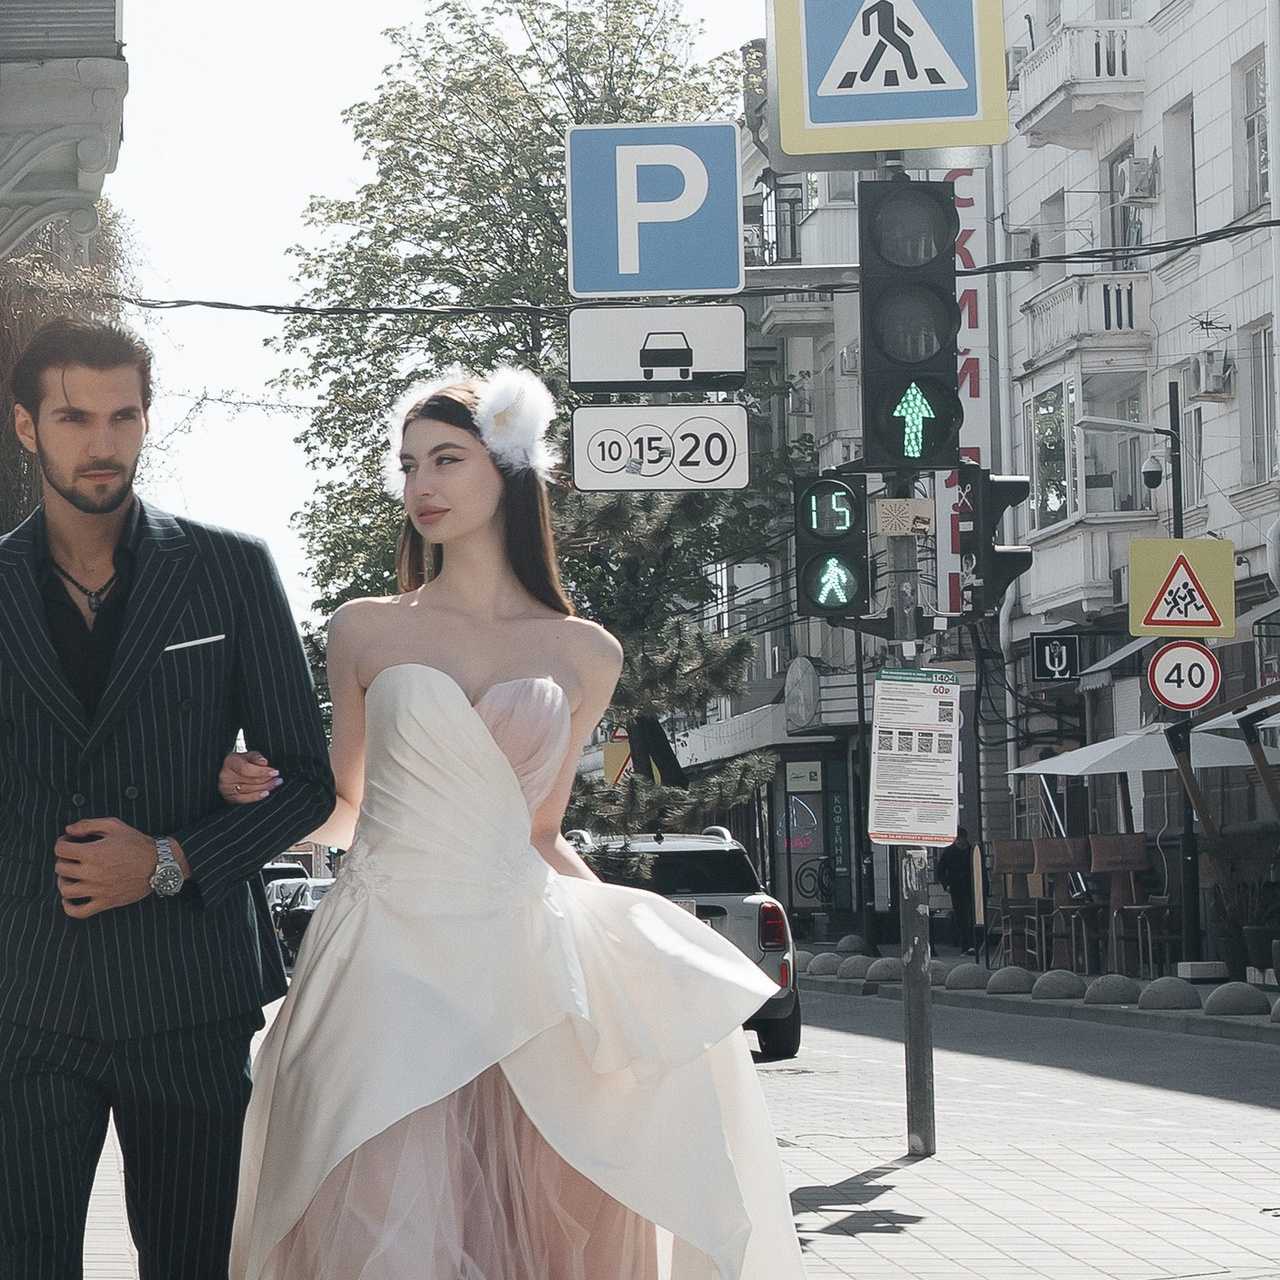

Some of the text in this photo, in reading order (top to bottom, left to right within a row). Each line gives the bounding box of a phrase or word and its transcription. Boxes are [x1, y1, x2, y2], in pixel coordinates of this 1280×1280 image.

[615, 143, 709, 275] P
[597, 432, 728, 467] 10 15 20
[811, 491, 850, 530] 15
[934, 673, 955, 683] 1404
[1163, 662, 1206, 689] 40
